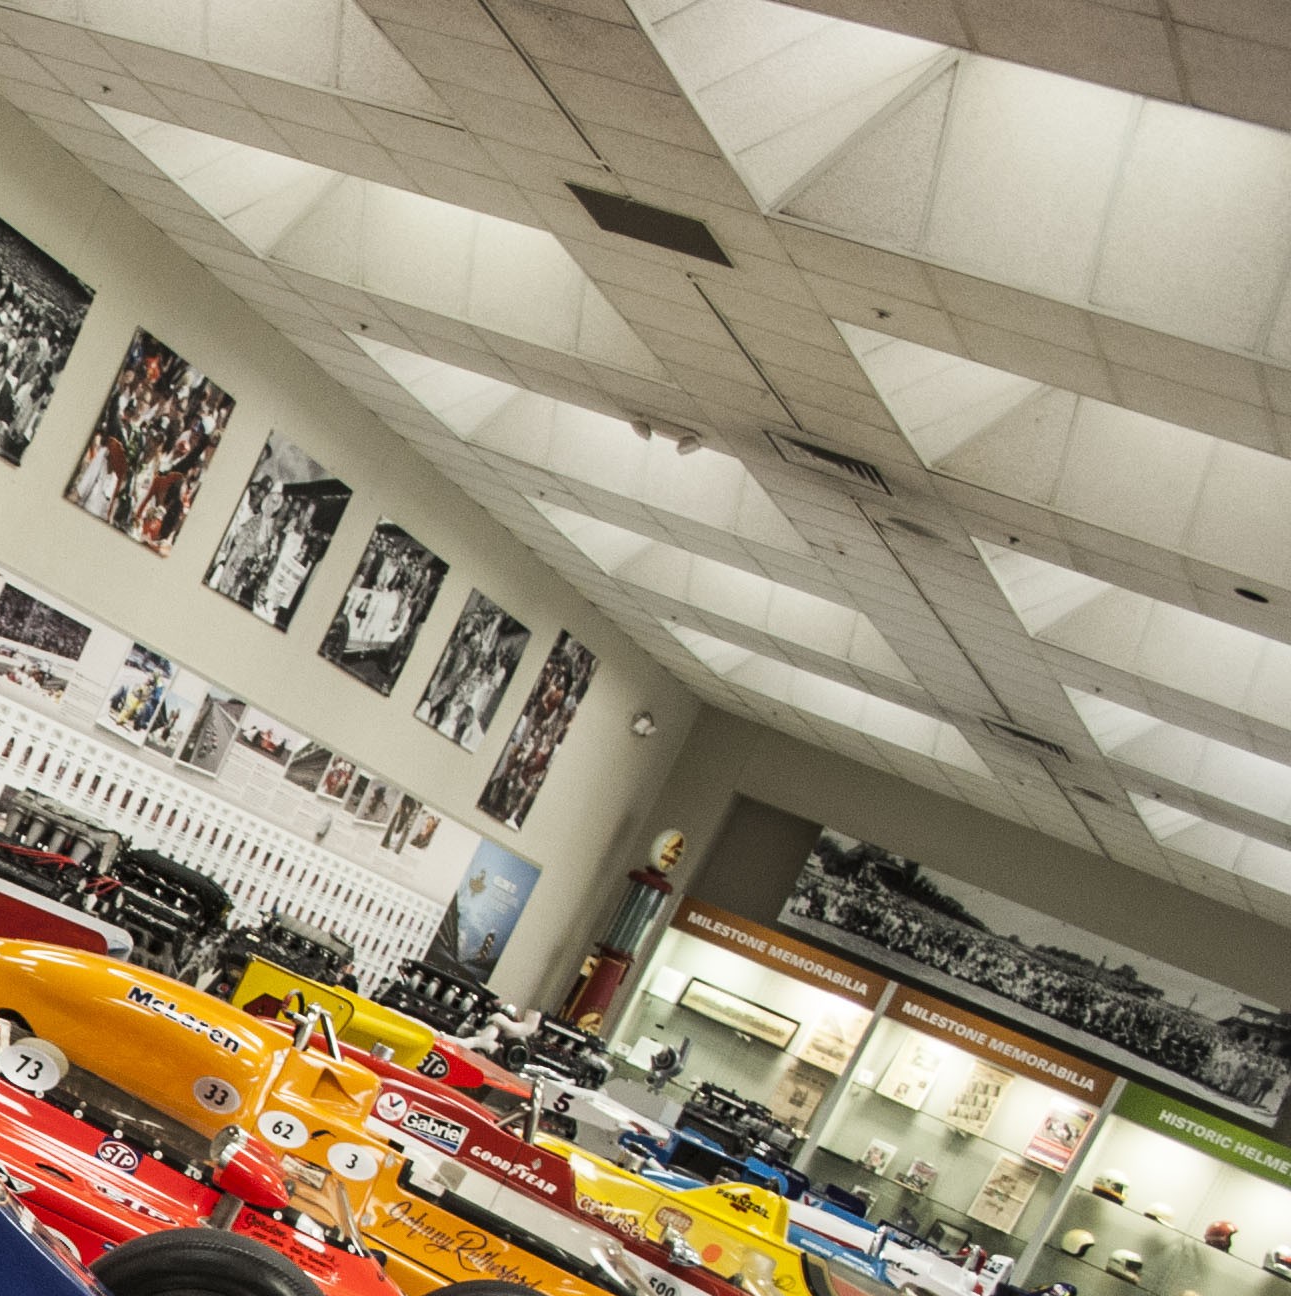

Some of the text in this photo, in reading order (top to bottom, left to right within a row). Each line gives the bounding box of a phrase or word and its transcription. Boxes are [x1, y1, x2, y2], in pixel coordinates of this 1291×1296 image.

[687, 910, 869, 997] MILESTONE MEMORABILIA
[901, 1000, 1096, 1093] MILESTONE MEMORABILIA
[15, 1054, 44, 1080] 73
[203, 1083, 228, 1107] 33
[554, 1093, 575, 1113] 5
[271, 1118, 295, 1140] 62
[403, 1110, 468, 1144] Gabriel
[101, 1144, 131, 1168] STP
[1158, 1108, 1291, 1177] HISTORIC HELME
[345, 1153, 359, 1170] 3
[470, 1146, 558, 1195] GOODYEAR
[715, 1187, 770, 1219] PENNZOIL
